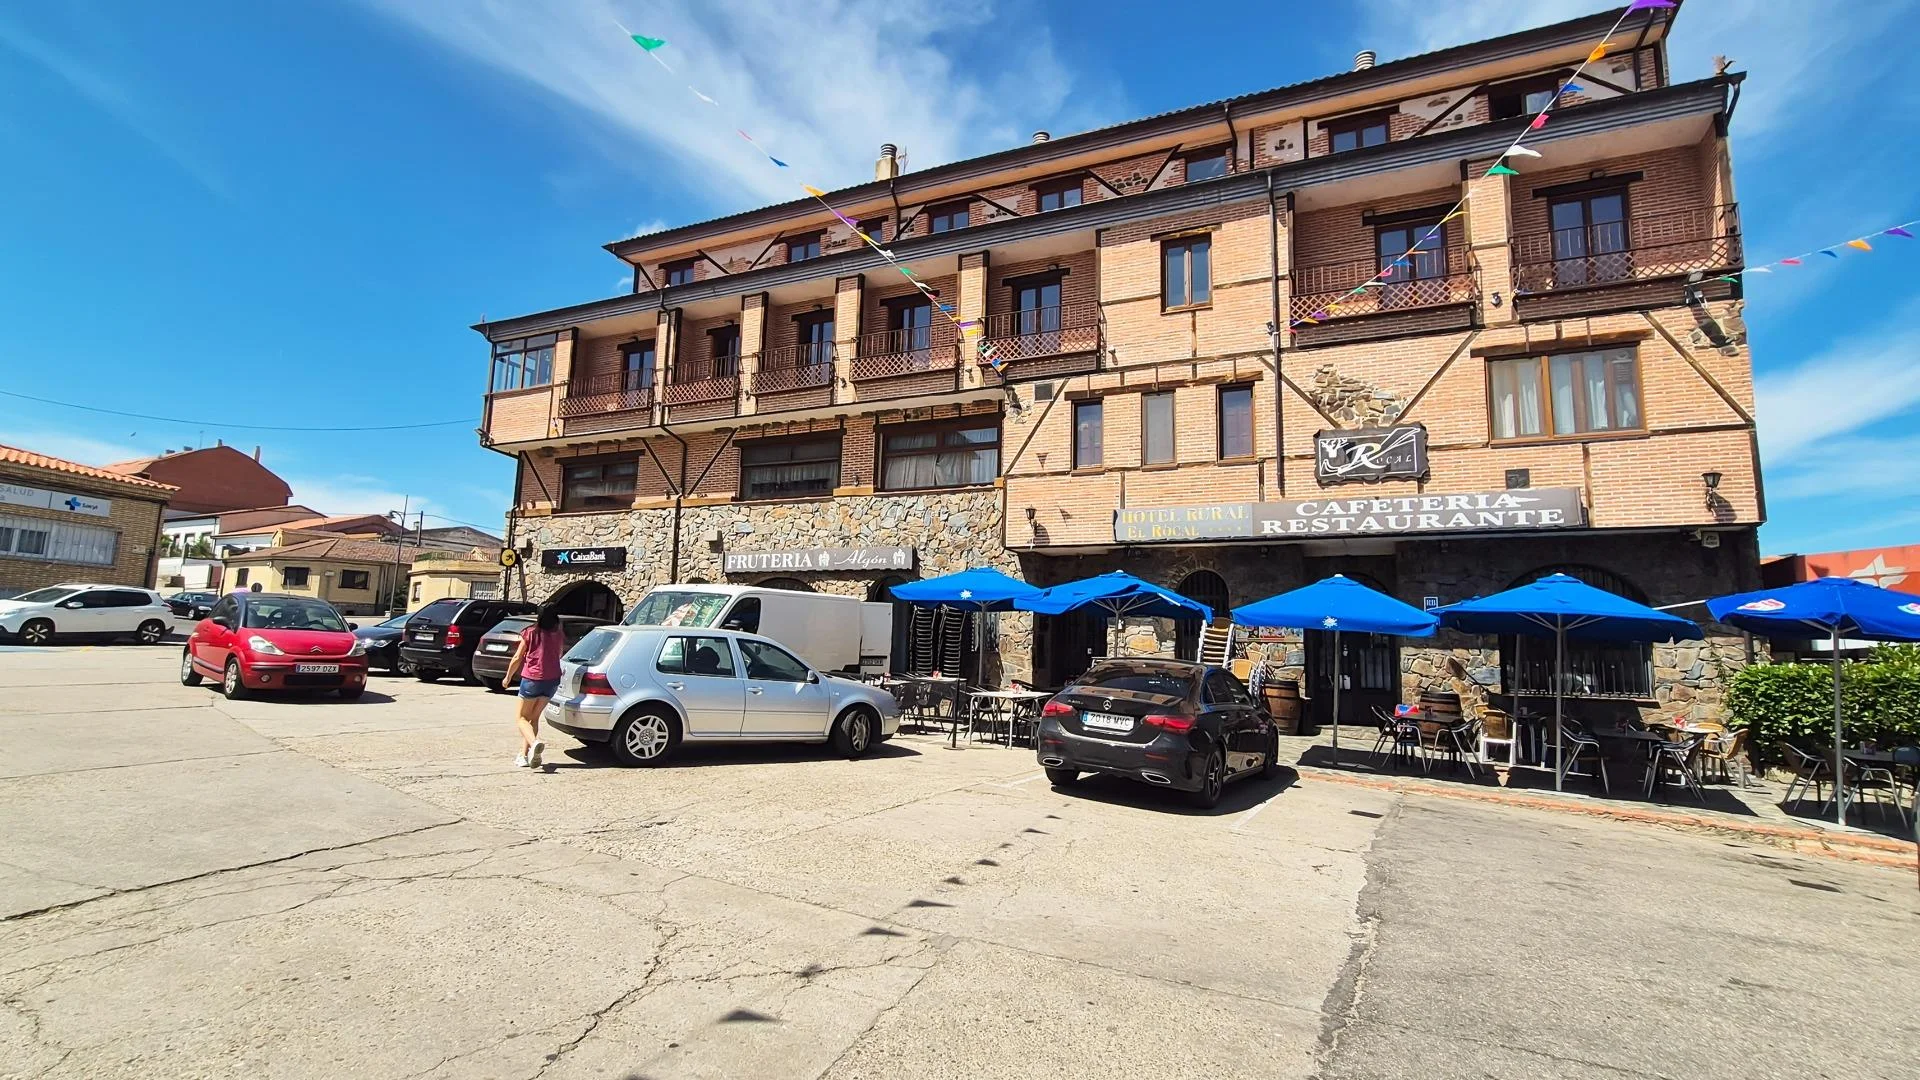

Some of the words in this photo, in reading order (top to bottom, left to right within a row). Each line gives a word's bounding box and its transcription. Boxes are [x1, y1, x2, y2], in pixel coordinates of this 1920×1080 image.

[1122, 508, 1181, 524] HOTEL
[1187, 505, 1249, 521] RURAL
[1295, 493, 1524, 517] CAFETERIA
[1260, 508, 1566, 534] RESTAURANTE
[570, 550, 606, 561] CaixaBank
[727, 552, 813, 570] FRUTERIA
[834, 549, 887, 568] Algón
[1090, 713, 1112, 724] 7018
